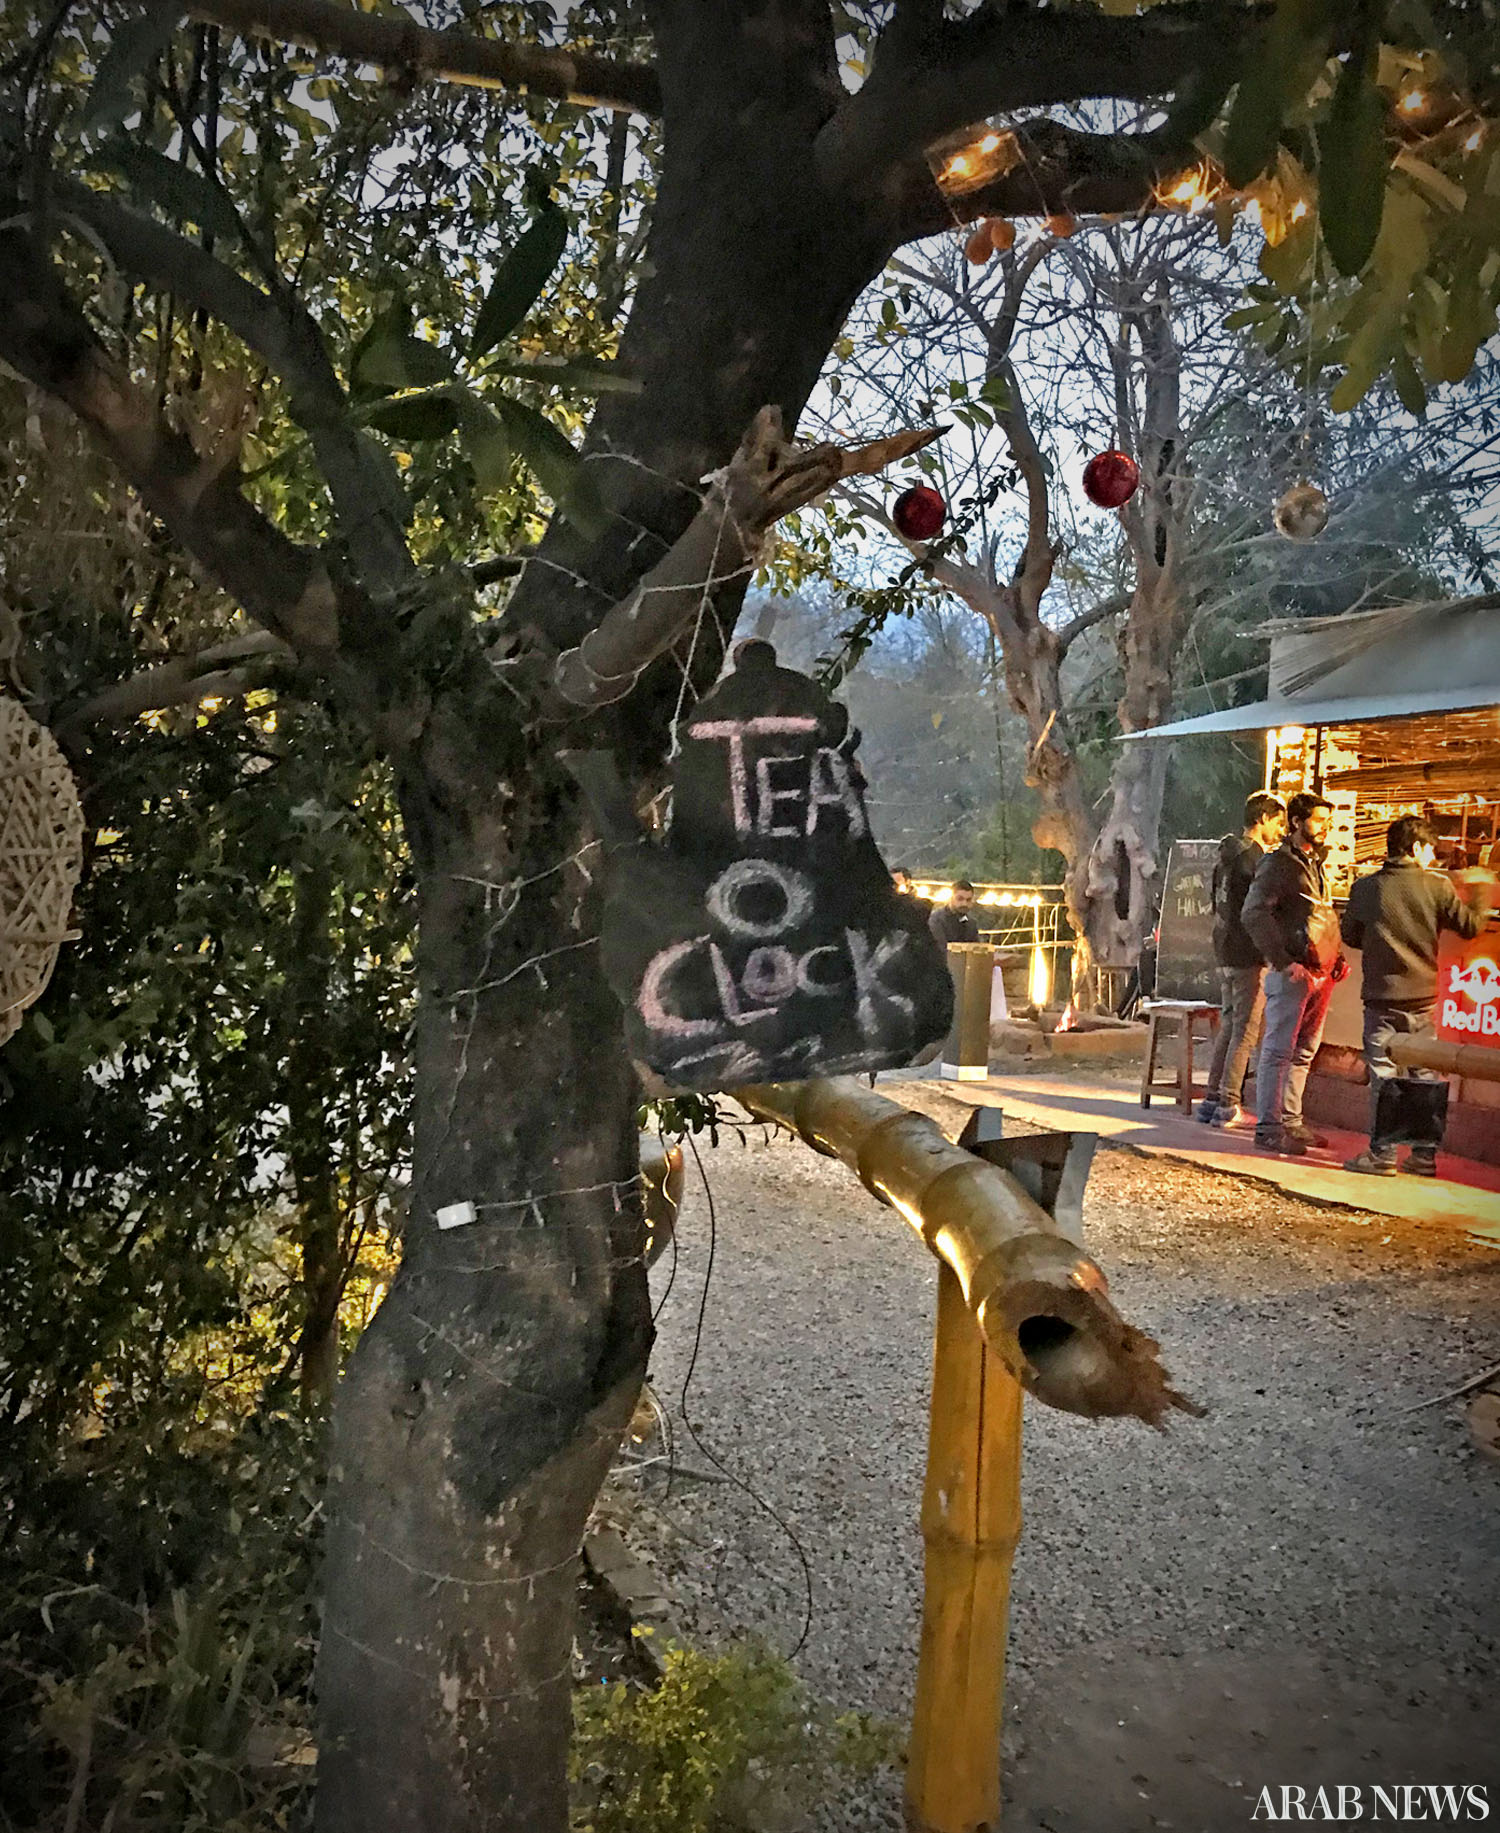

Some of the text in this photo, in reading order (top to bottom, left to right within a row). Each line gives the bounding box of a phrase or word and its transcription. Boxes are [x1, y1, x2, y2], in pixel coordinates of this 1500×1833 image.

[688, 716, 865, 840] TEA
[706, 858, 813, 938] O
[1177, 898, 1213, 917] HALW
[638, 926, 915, 1037] CLOCK
[1442, 999, 1480, 1032] Red
